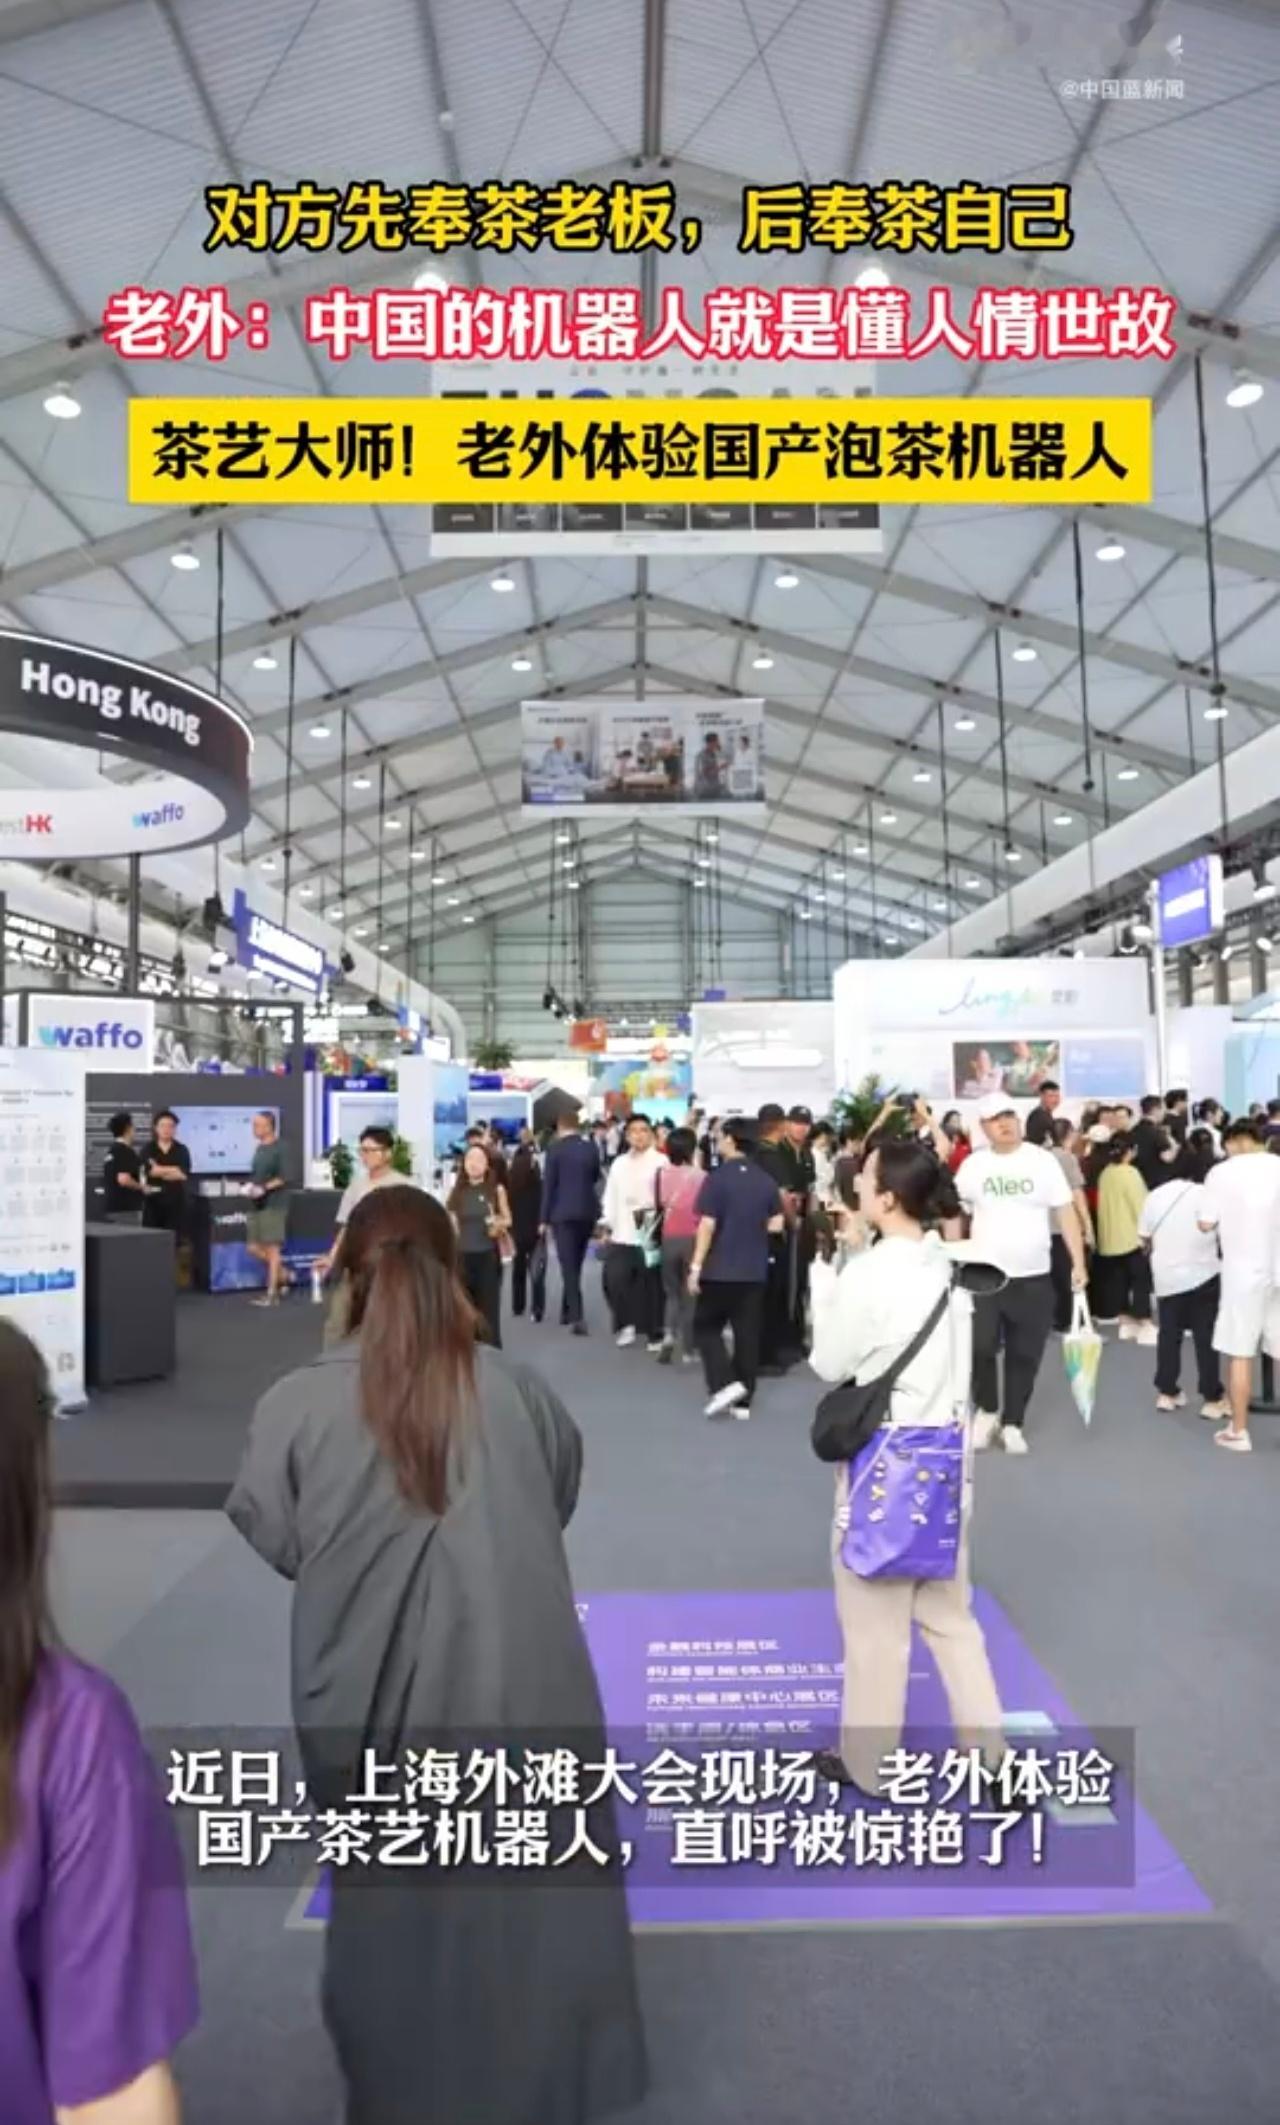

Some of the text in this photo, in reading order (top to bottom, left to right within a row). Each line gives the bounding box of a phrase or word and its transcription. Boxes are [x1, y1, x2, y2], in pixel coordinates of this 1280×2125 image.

[21, 658, 202, 746] Hong Kong
[131, 802, 185, 828] waffo
[38, 1021, 143, 1050] waffo
[982, 1176, 1035, 1197] Aleo
